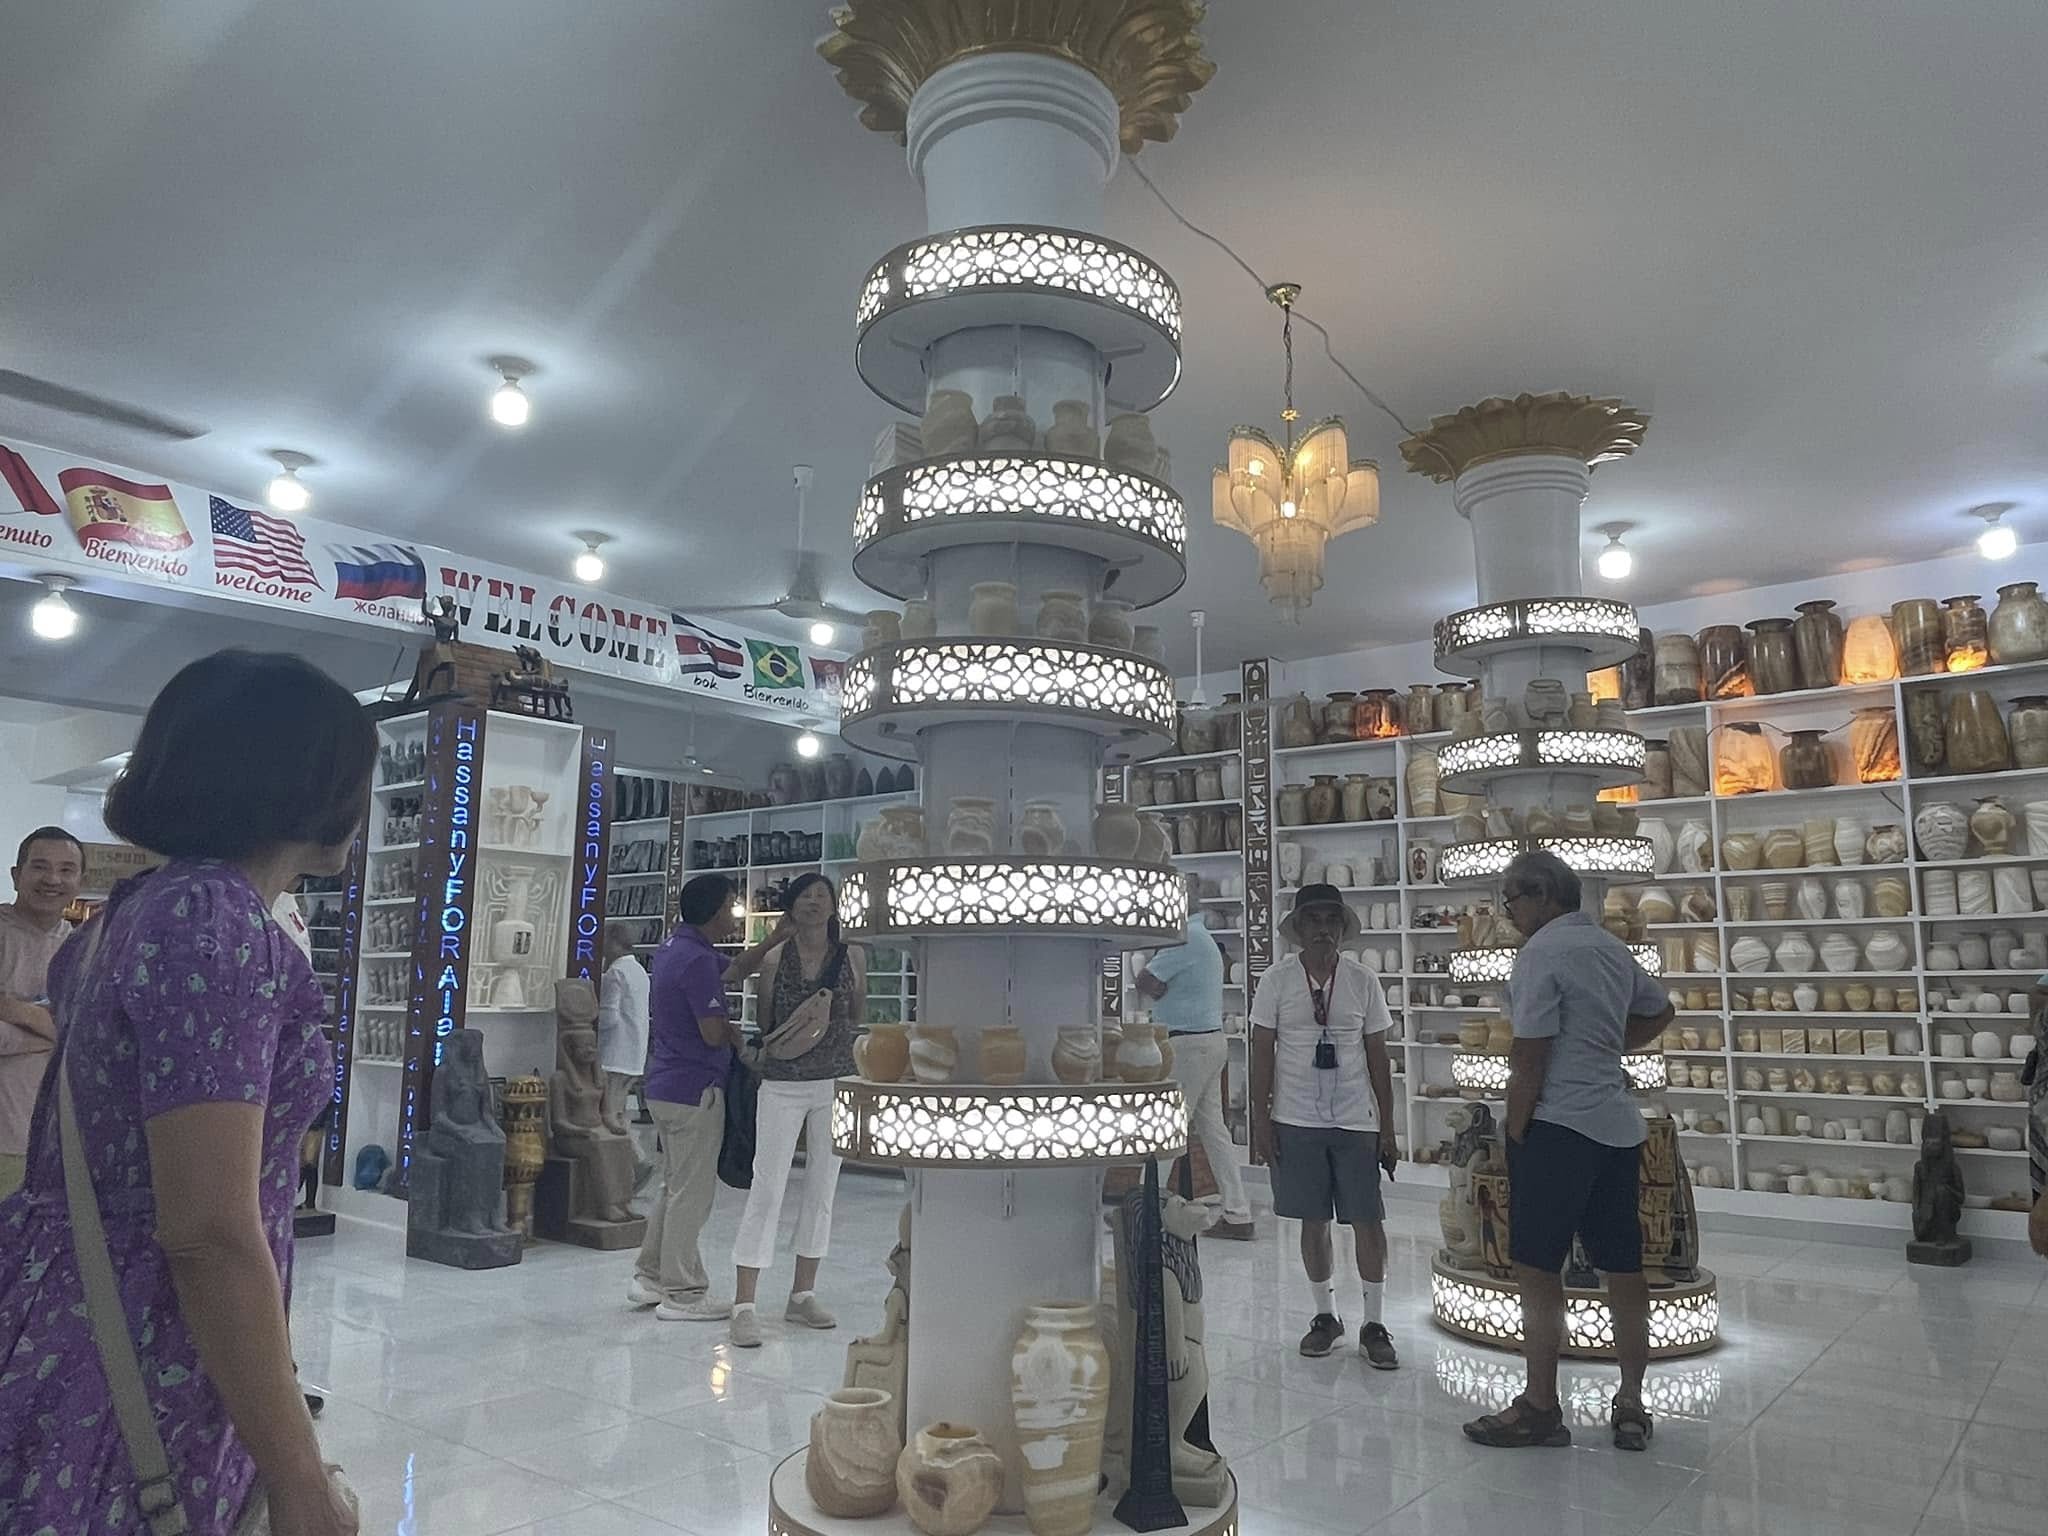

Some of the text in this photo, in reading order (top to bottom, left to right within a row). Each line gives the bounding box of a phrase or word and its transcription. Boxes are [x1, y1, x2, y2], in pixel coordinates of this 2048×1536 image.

[85, 537, 188, 578] Bienvenido
[215, 570, 313, 603] welcome
[440, 567, 667, 668] WELCOME
